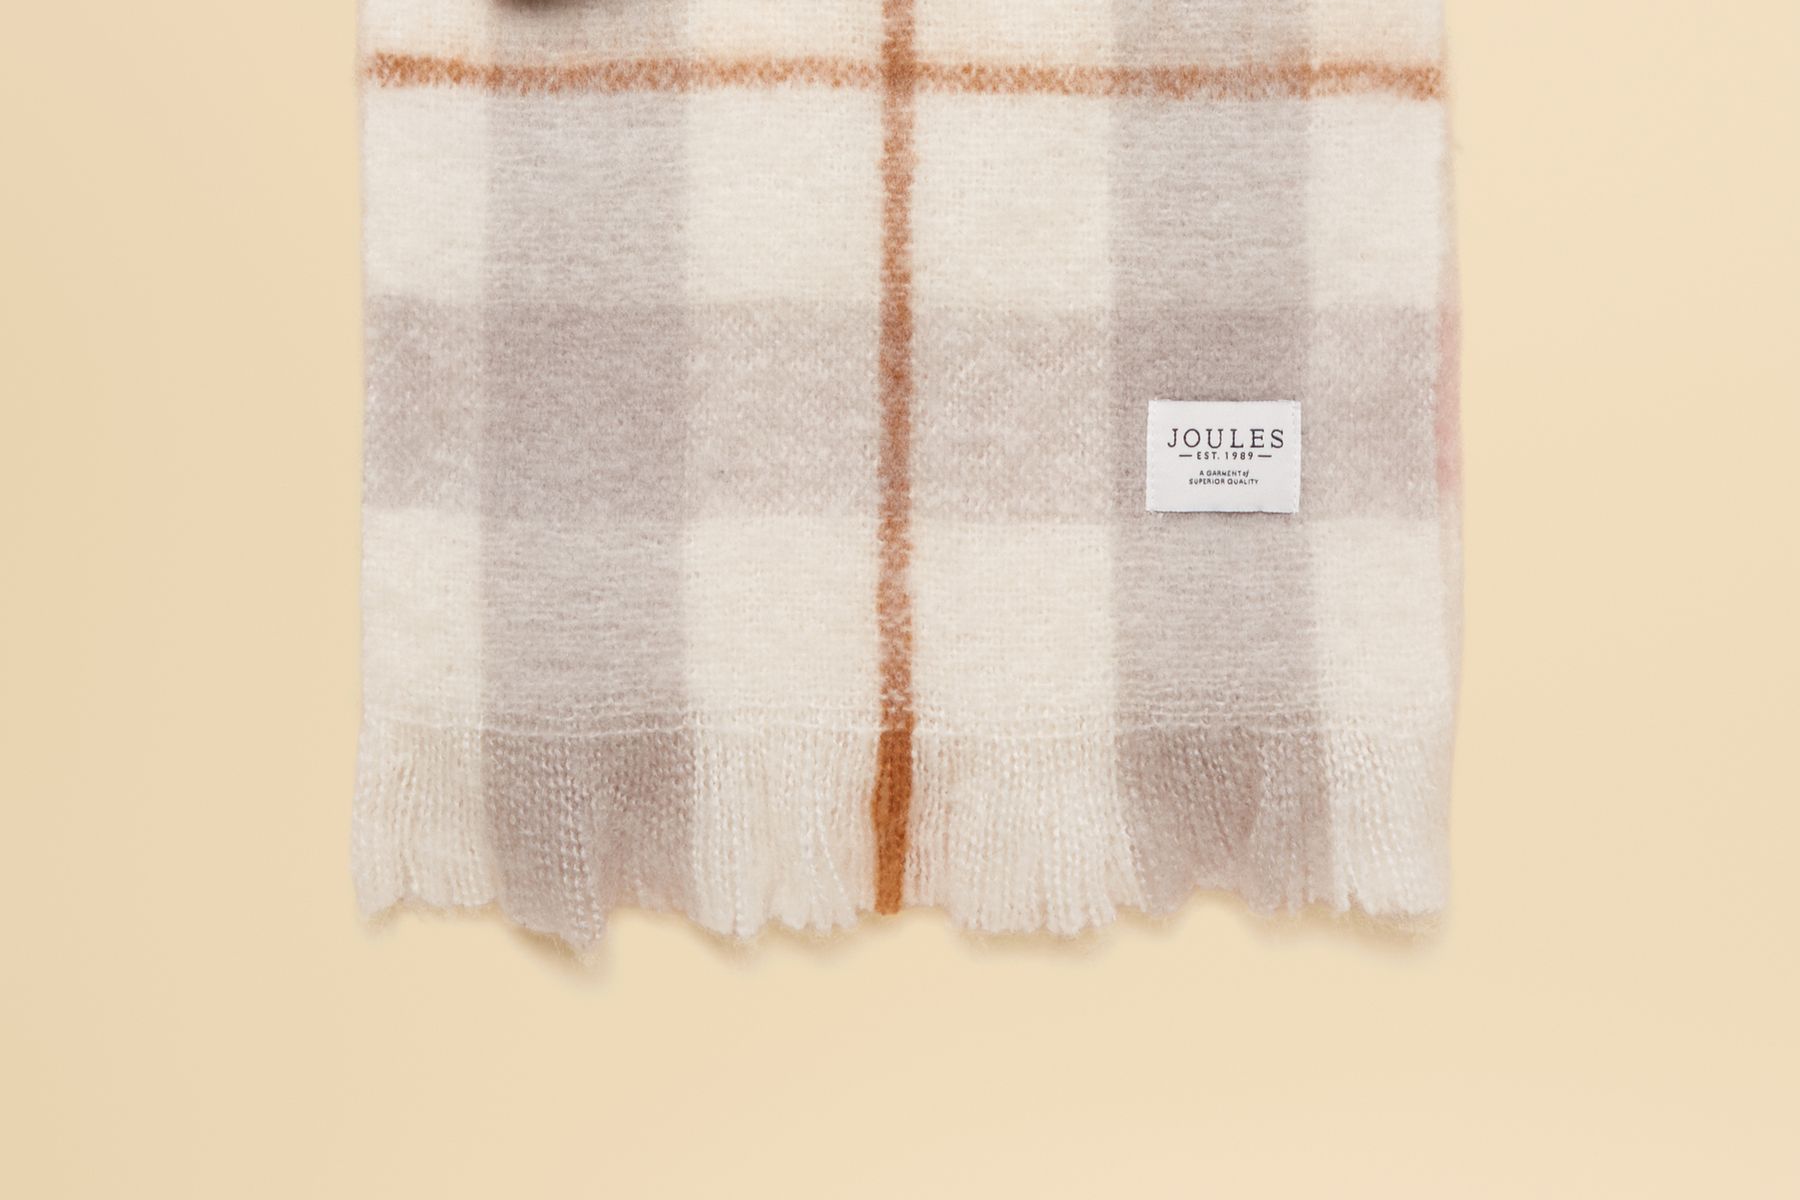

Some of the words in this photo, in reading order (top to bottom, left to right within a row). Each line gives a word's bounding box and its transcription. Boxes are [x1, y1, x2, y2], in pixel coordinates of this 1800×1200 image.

[1167, 428, 1284, 449] JOULES
[1196, 451, 1220, 460] EST.
[1225, 451, 1254, 460] 1989
[1206, 469, 1241, 477] GARMENT
[1242, 469, 1250, 478] of
